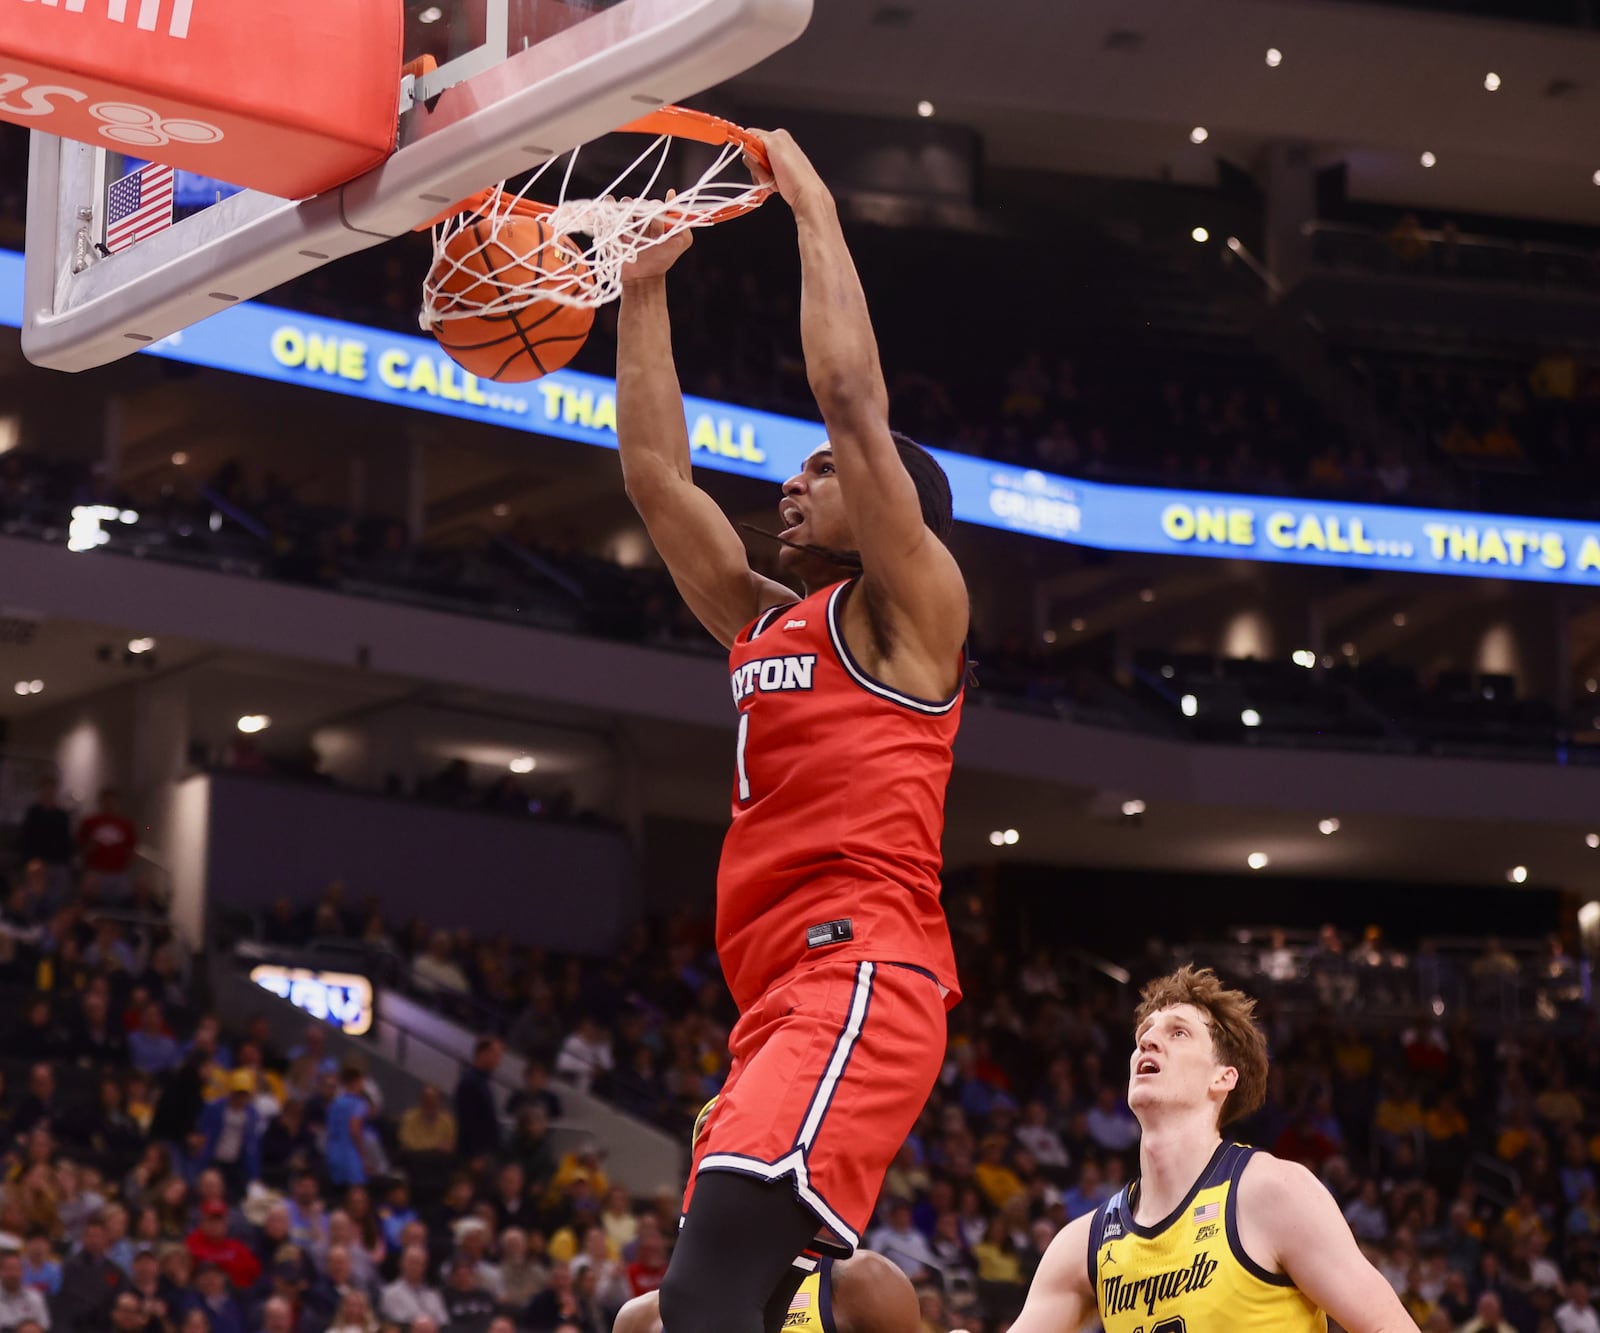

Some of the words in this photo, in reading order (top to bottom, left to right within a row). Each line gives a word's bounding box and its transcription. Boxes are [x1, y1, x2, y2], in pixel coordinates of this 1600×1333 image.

[271, 327, 367, 381] ONE
[538, 381, 616, 433] THA
[689, 414, 766, 464] ALL
[1162, 504, 1255, 546] ONE
[1266, 511, 1414, 558] CALL...
[1423, 522, 1565, 569] THAT'S
[837, 925, 845, 935] L
[1195, 1228, 1220, 1241] EAST
[1199, 1224, 1216, 1234] BIG
[1102, 1251, 1218, 1318] Marquette
